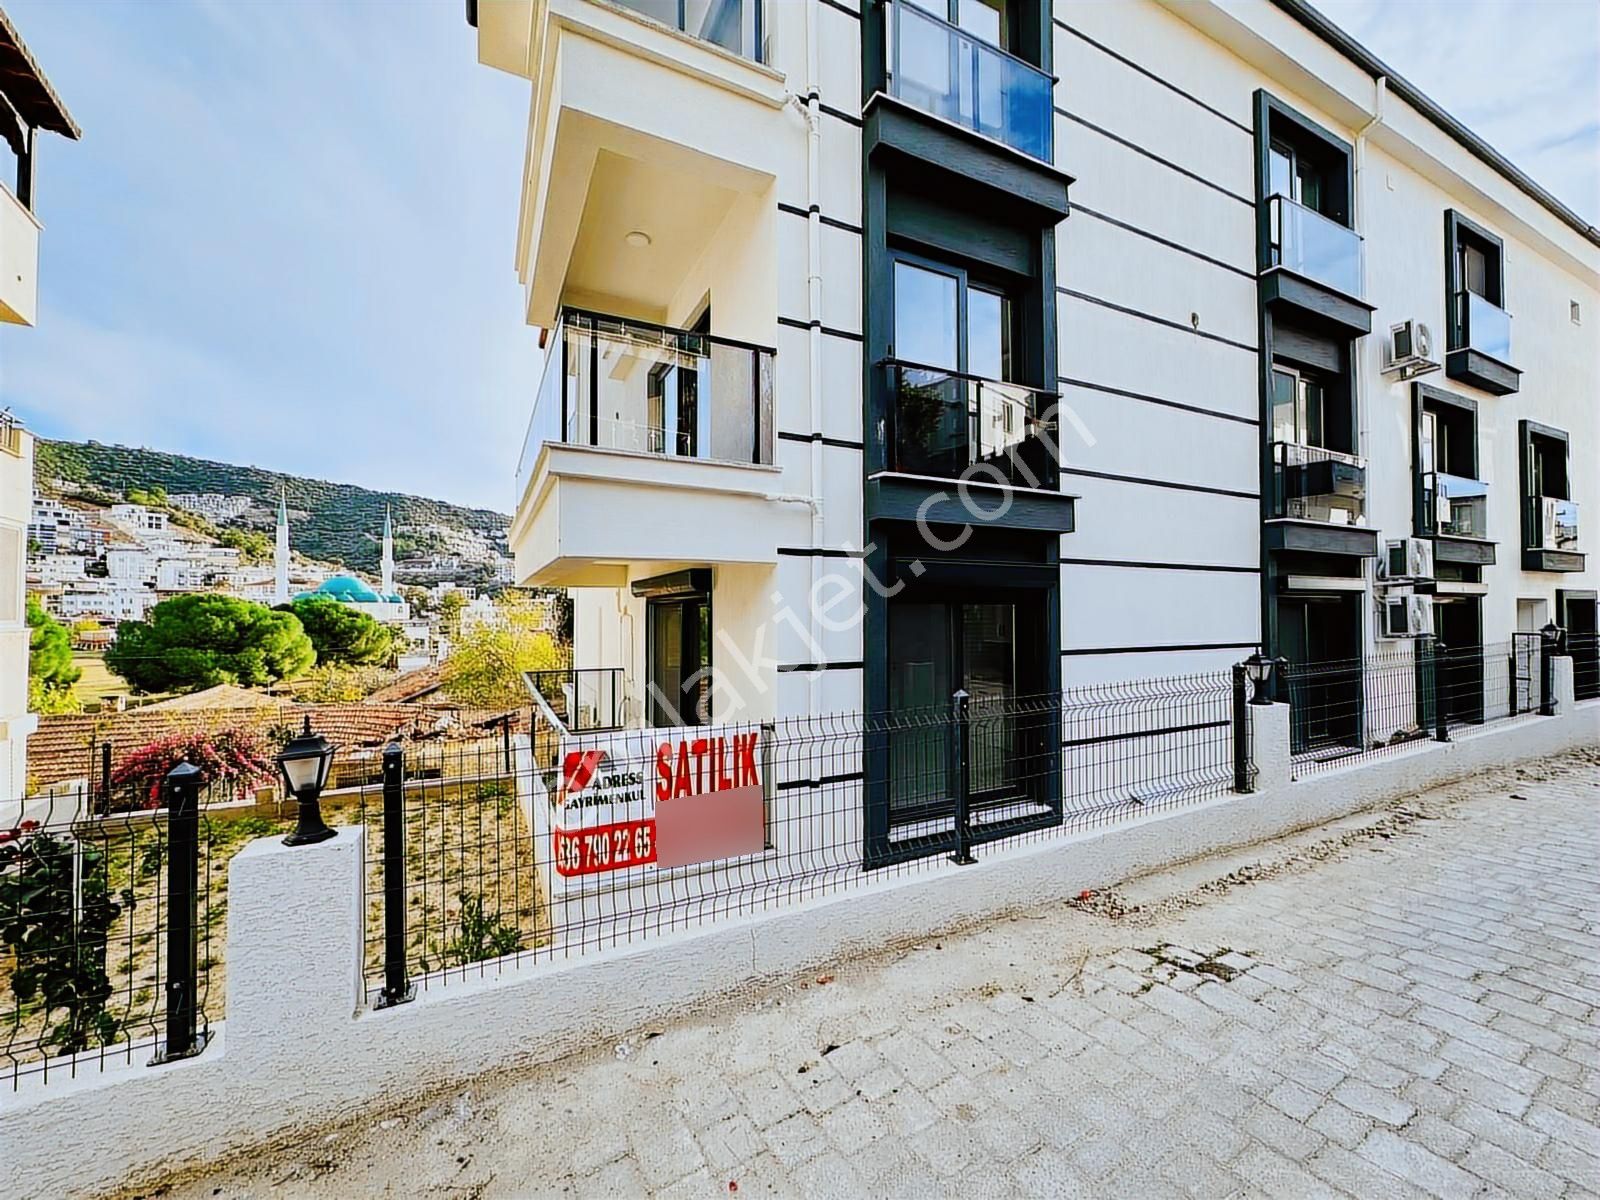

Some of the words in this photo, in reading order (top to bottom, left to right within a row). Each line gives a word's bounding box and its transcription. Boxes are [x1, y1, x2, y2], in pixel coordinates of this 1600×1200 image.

[592, 771, 643, 790] ADRESS
[656, 733, 758, 801] SATILIK
[585, 832, 610, 868] 790
[614, 829, 631, 863] 22
[635, 826, 651, 859] 65
